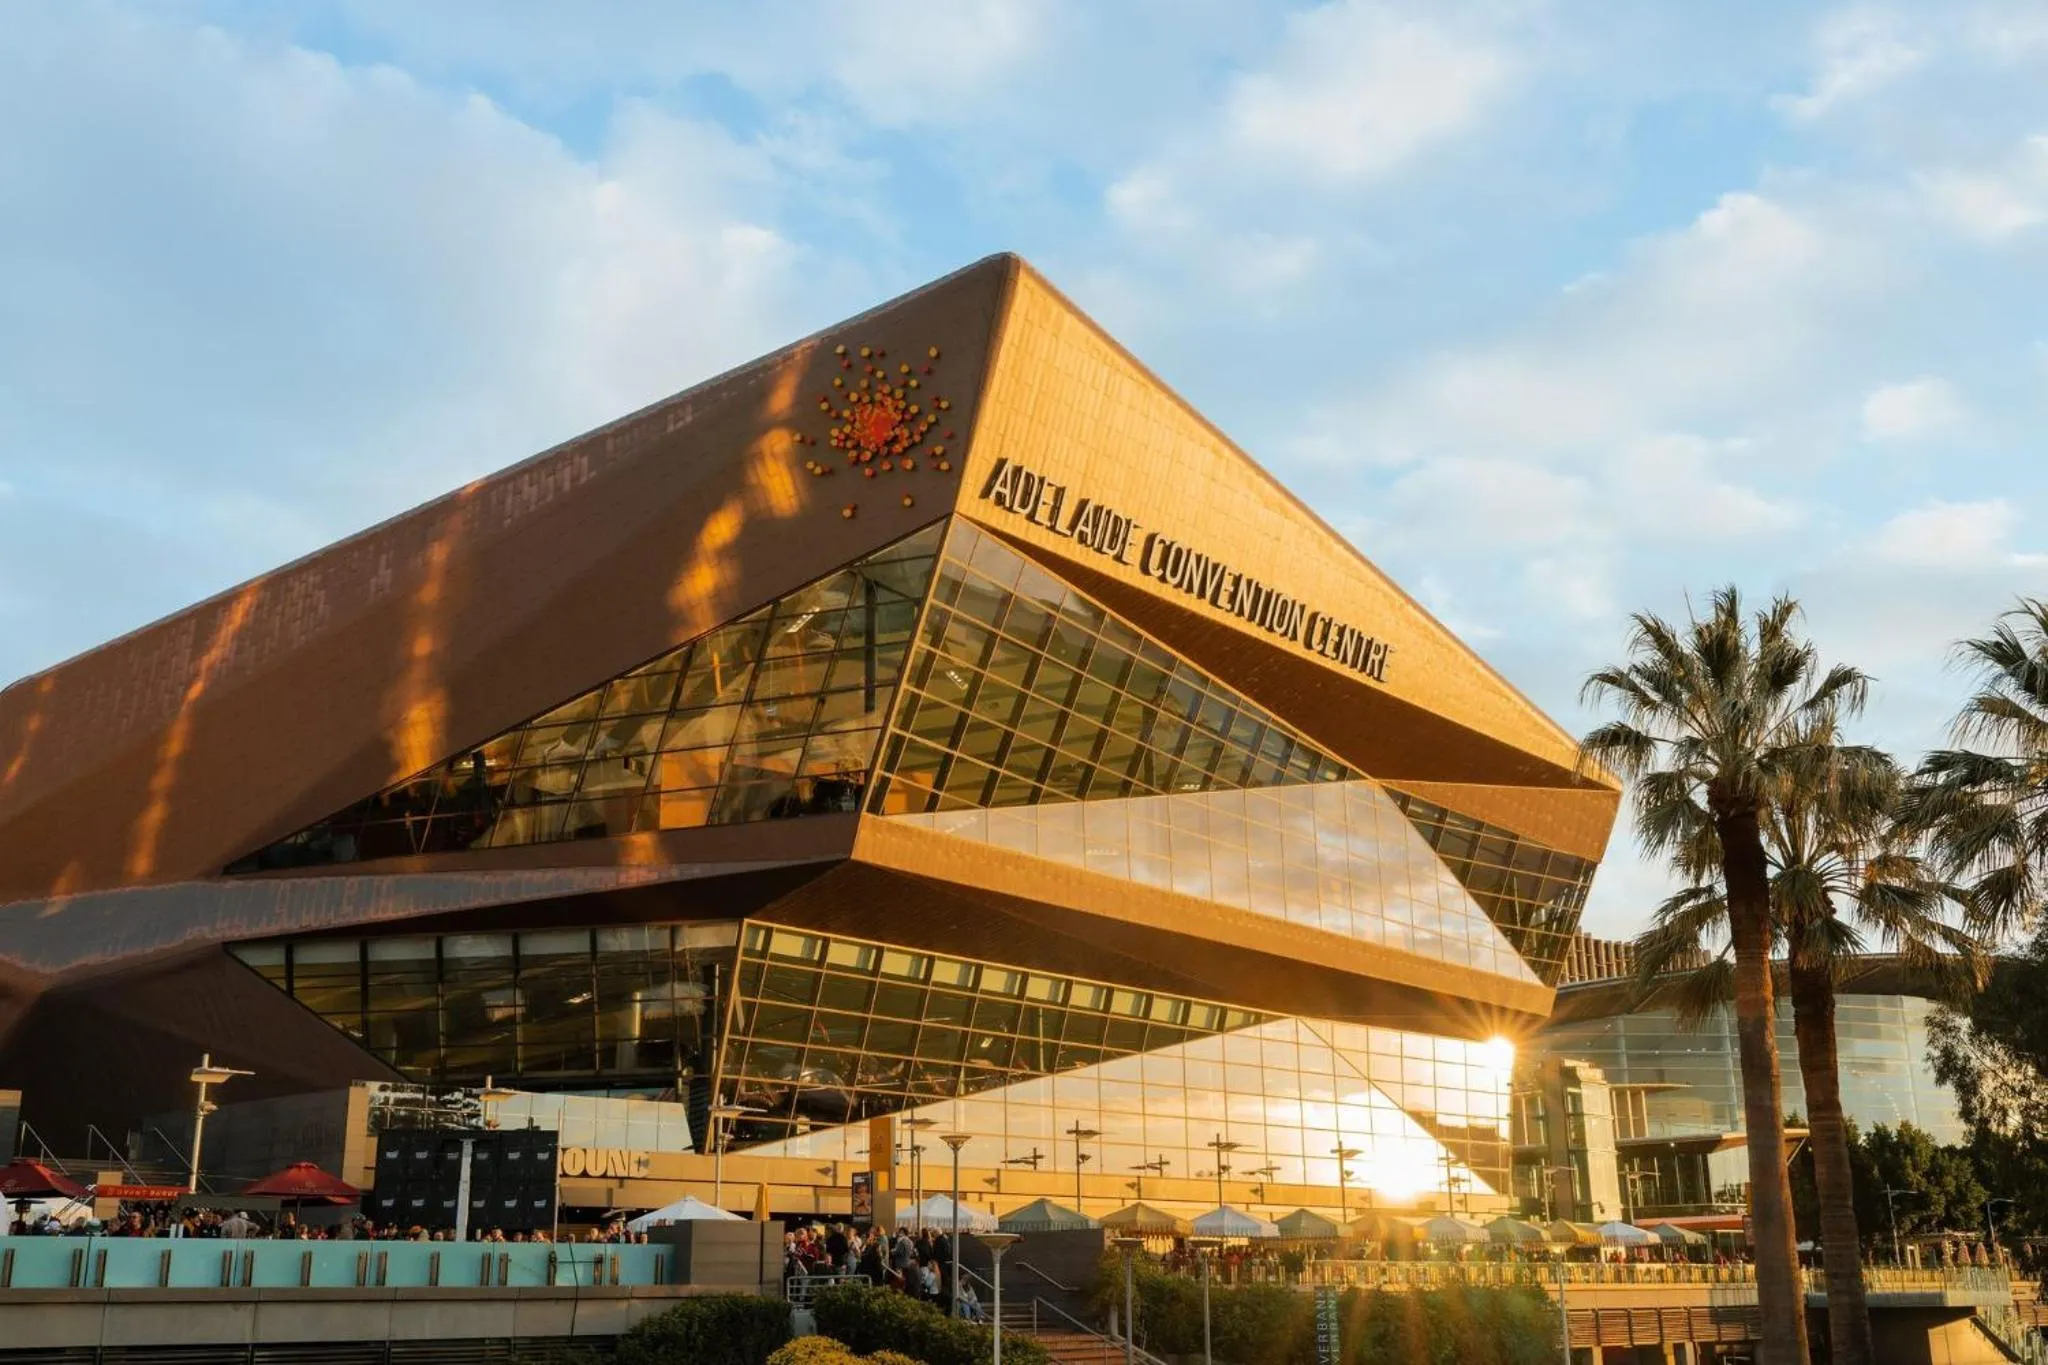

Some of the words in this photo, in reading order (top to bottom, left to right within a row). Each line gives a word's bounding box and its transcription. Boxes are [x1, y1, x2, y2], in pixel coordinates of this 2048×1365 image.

[984, 459, 1142, 565] ADELAIDE
[1145, 533, 1306, 641] CONVENTION
[1310, 612, 1396, 683] CENTRE
[560, 1147, 648, 1178] OUND
